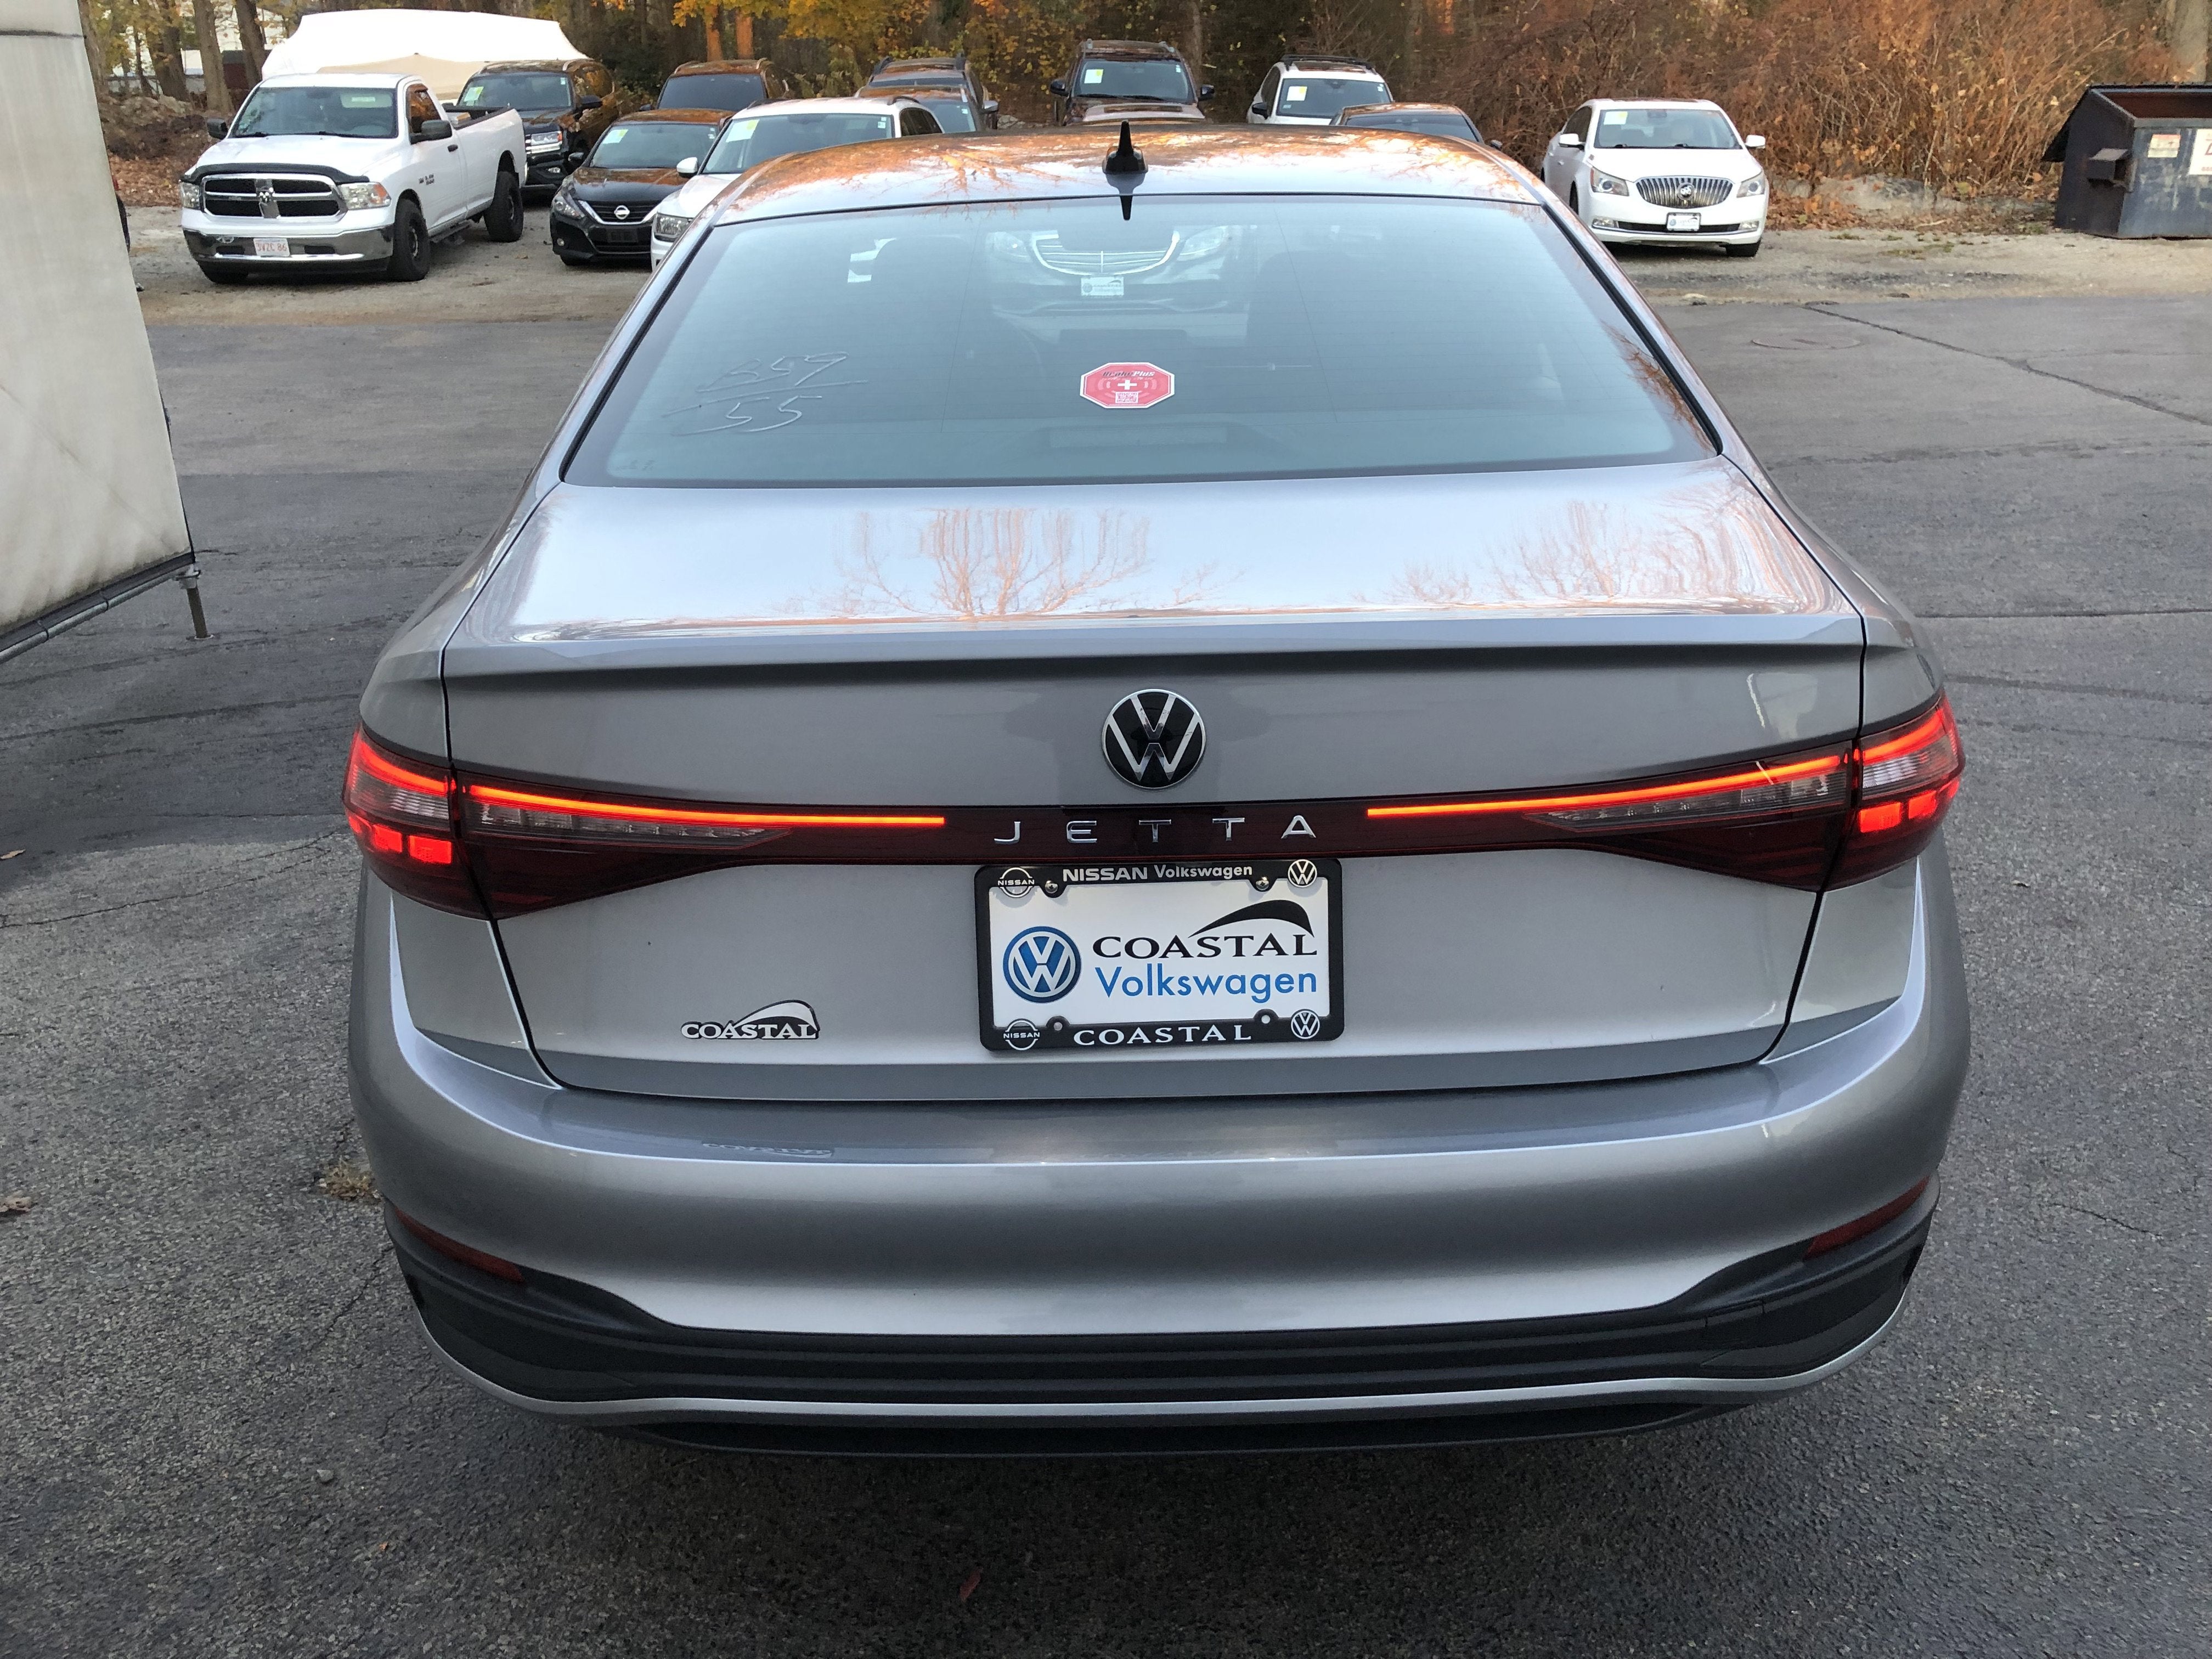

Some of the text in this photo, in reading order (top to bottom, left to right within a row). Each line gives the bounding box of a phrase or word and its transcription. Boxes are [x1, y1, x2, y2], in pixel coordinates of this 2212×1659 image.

[994, 814, 1317, 845] JETTA
[1063, 864, 1253, 882] NISSAN Volkswagen
[1092, 934, 1317, 960] COASTAL
[1094, 963, 1317, 1004] Volkswagen
[681, 1023, 817, 1040] COASTAL
[1073, 1024, 1251, 1046] COASTAL
